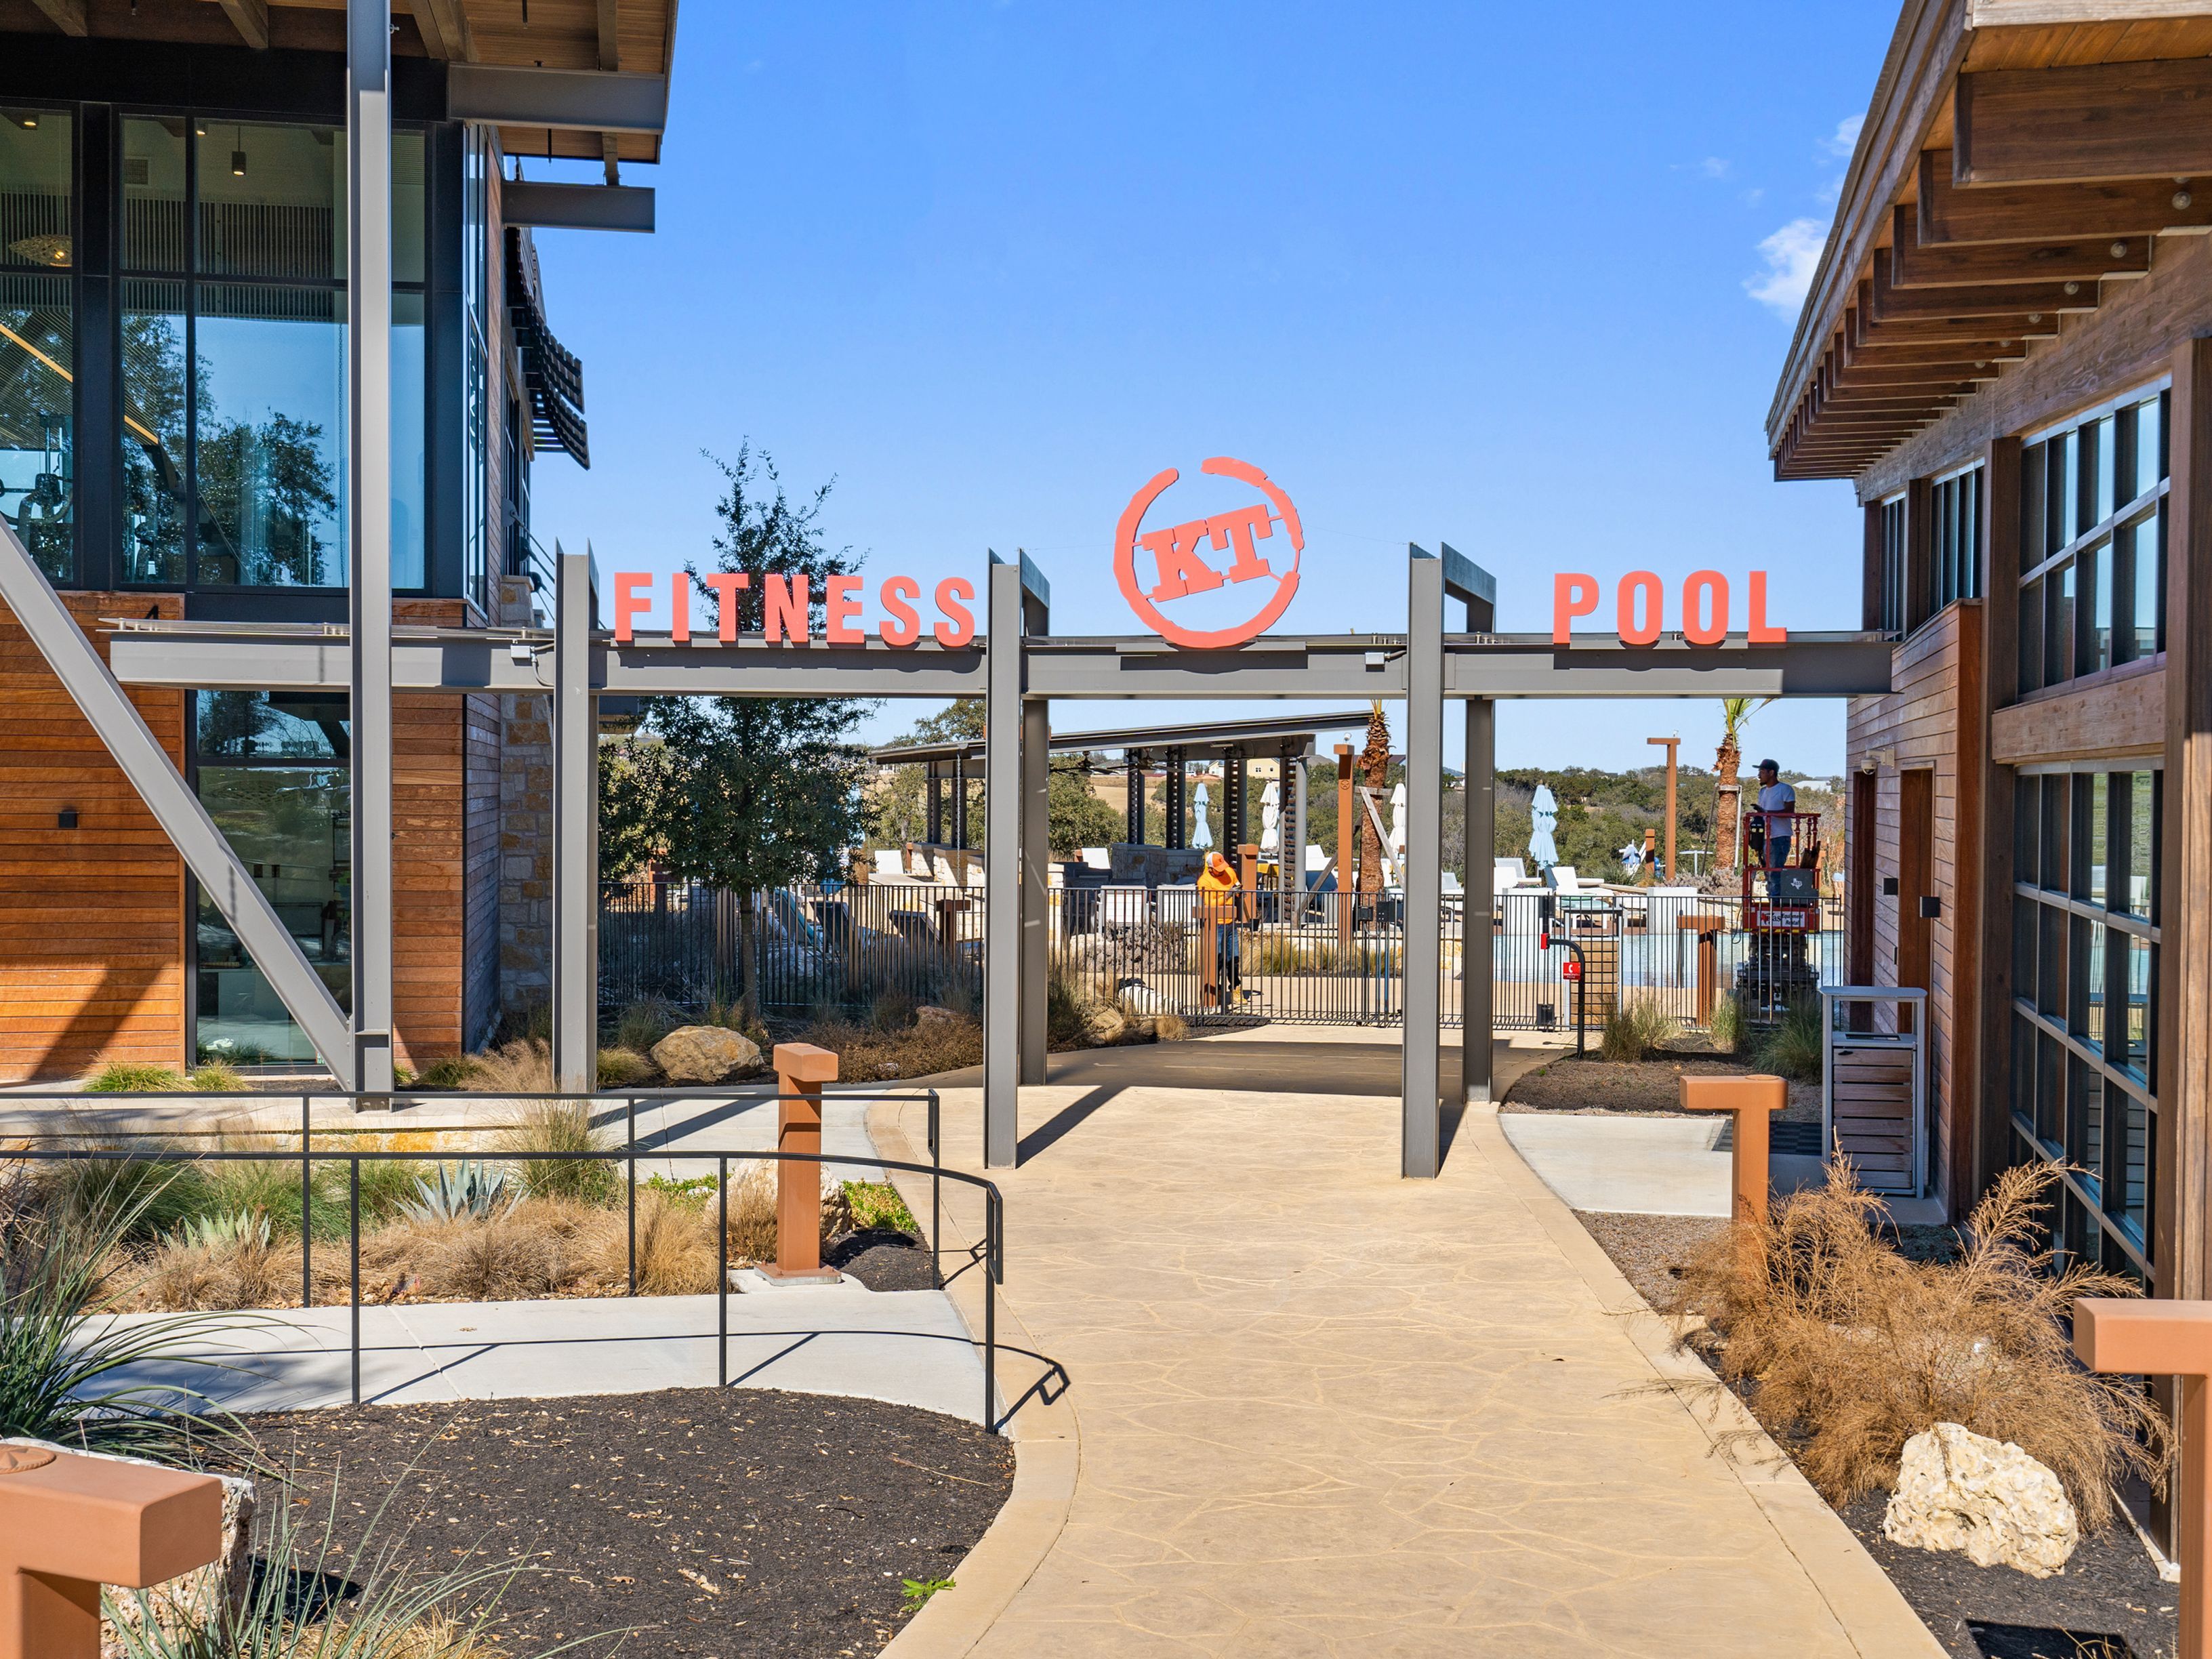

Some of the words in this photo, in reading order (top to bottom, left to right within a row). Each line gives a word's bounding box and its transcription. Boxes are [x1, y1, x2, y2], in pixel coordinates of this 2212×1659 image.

[1141, 504, 1273, 602] KT
[614, 572, 975, 647] FITNESS
[1553, 570, 1786, 644] POOL
